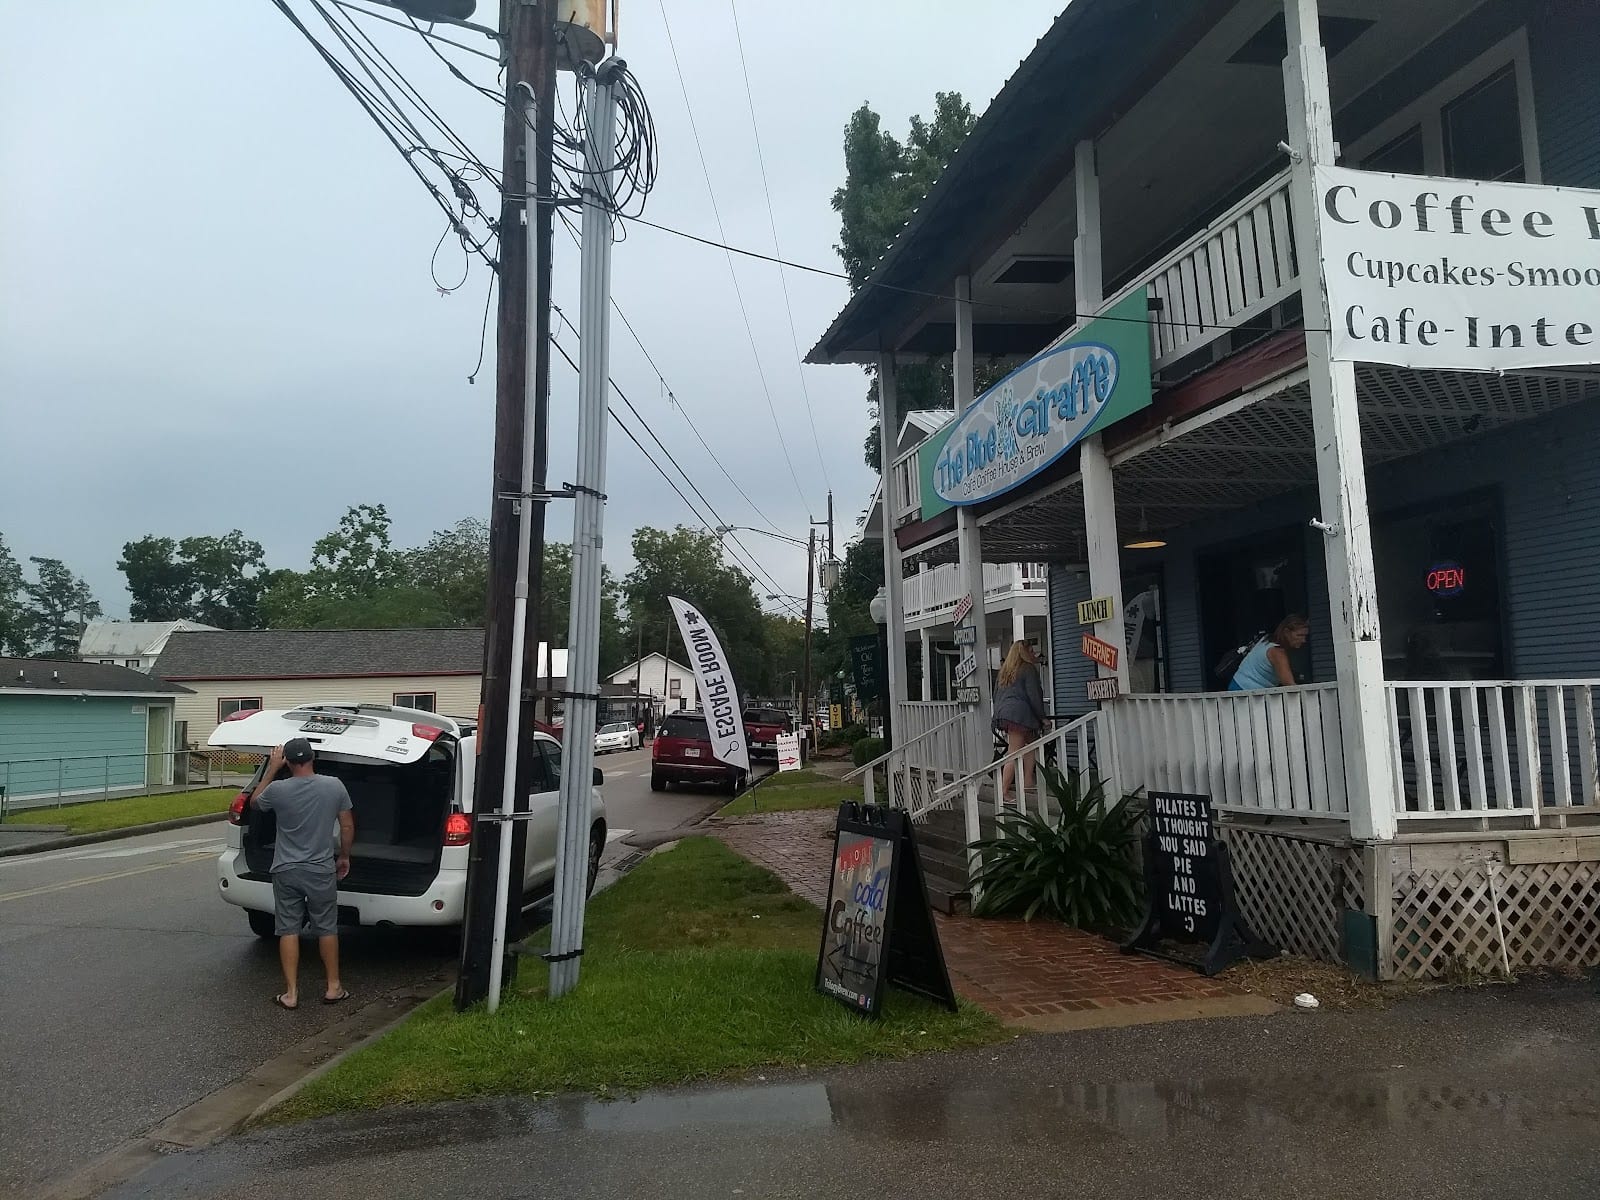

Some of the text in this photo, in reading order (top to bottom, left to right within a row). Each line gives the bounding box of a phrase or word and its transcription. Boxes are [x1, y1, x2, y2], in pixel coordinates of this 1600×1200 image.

[1324, 185, 1555, 238] Coffee
[1347, 251, 1600, 288] Cupcakes-Smoo
[1345, 305, 1594, 348] Cafe-Inte
[937, 353, 1110, 493] The Blue Giraffe
[977, 468, 996, 488] Coffee
[998, 455, 1018, 478] House
[1019, 451, 1025, 464] &
[1026, 441, 1046, 462] Brew
[1427, 569, 1464, 590] OPEN
[1081, 600, 1108, 622] LUNCH
[1082, 636, 1116, 667] INTERNET
[956, 655, 976, 679] LATTE
[1087, 679, 1117, 700] DESSERTS
[1155, 798, 1196, 817] PILATES
[1155, 817, 1209, 838] I THOUGHT
[1159, 836, 1207, 857] YOU SAID
[1173, 856, 1193, 875] PIE
[854, 870, 888, 912] cold
[1173, 875, 1196, 895] AND
[1168, 893, 1207, 917] LATTES
[831, 900, 881, 944] Coffee
